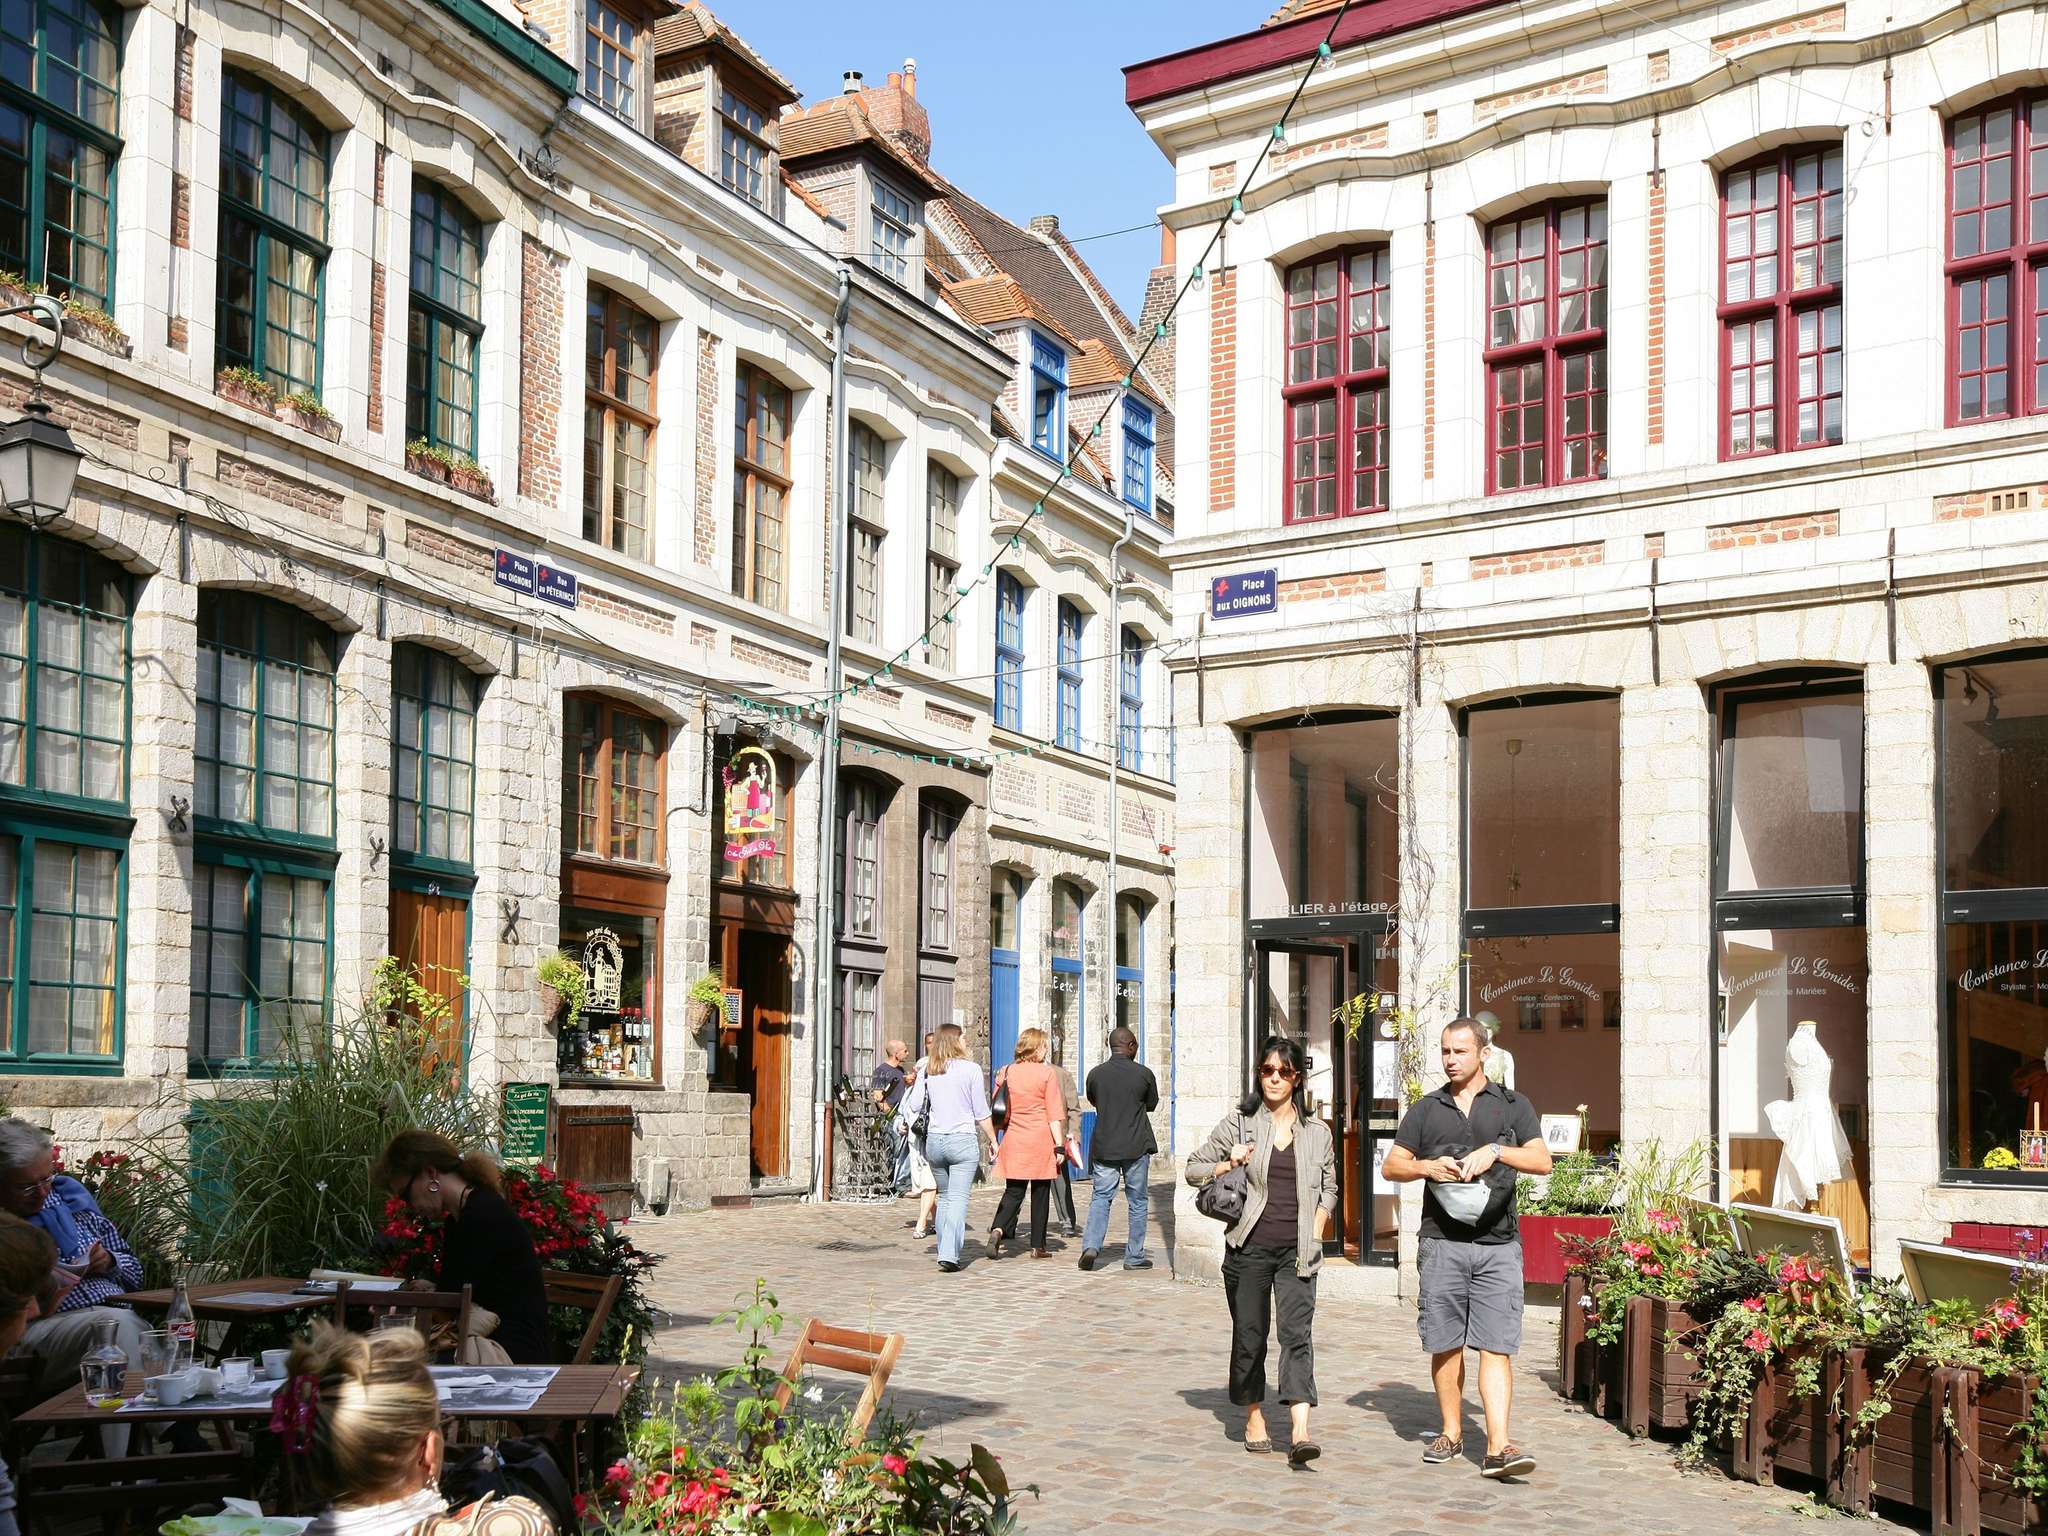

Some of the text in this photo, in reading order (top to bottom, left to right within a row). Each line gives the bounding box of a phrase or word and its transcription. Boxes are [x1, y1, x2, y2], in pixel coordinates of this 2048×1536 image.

[514, 560, 529, 573] Place
[498, 571, 532, 589] aux OIGNONS
[557, 575, 568, 587] Rue
[1242, 579, 1265, 591] Place
[538, 585, 546, 593] au
[1216, 593, 1271, 611] aux OIGNONS
[1328, 901, 1337, 913] à
[1341, 901, 1388, 914] l'étage
[1959, 948, 2048, 991] Constance L
[1725, 956, 1859, 997] Constance Le Gonidec
[1480, 966, 1600, 1003] Constance Le Gonidec
[2000, 983, 2026, 991] Styliste
